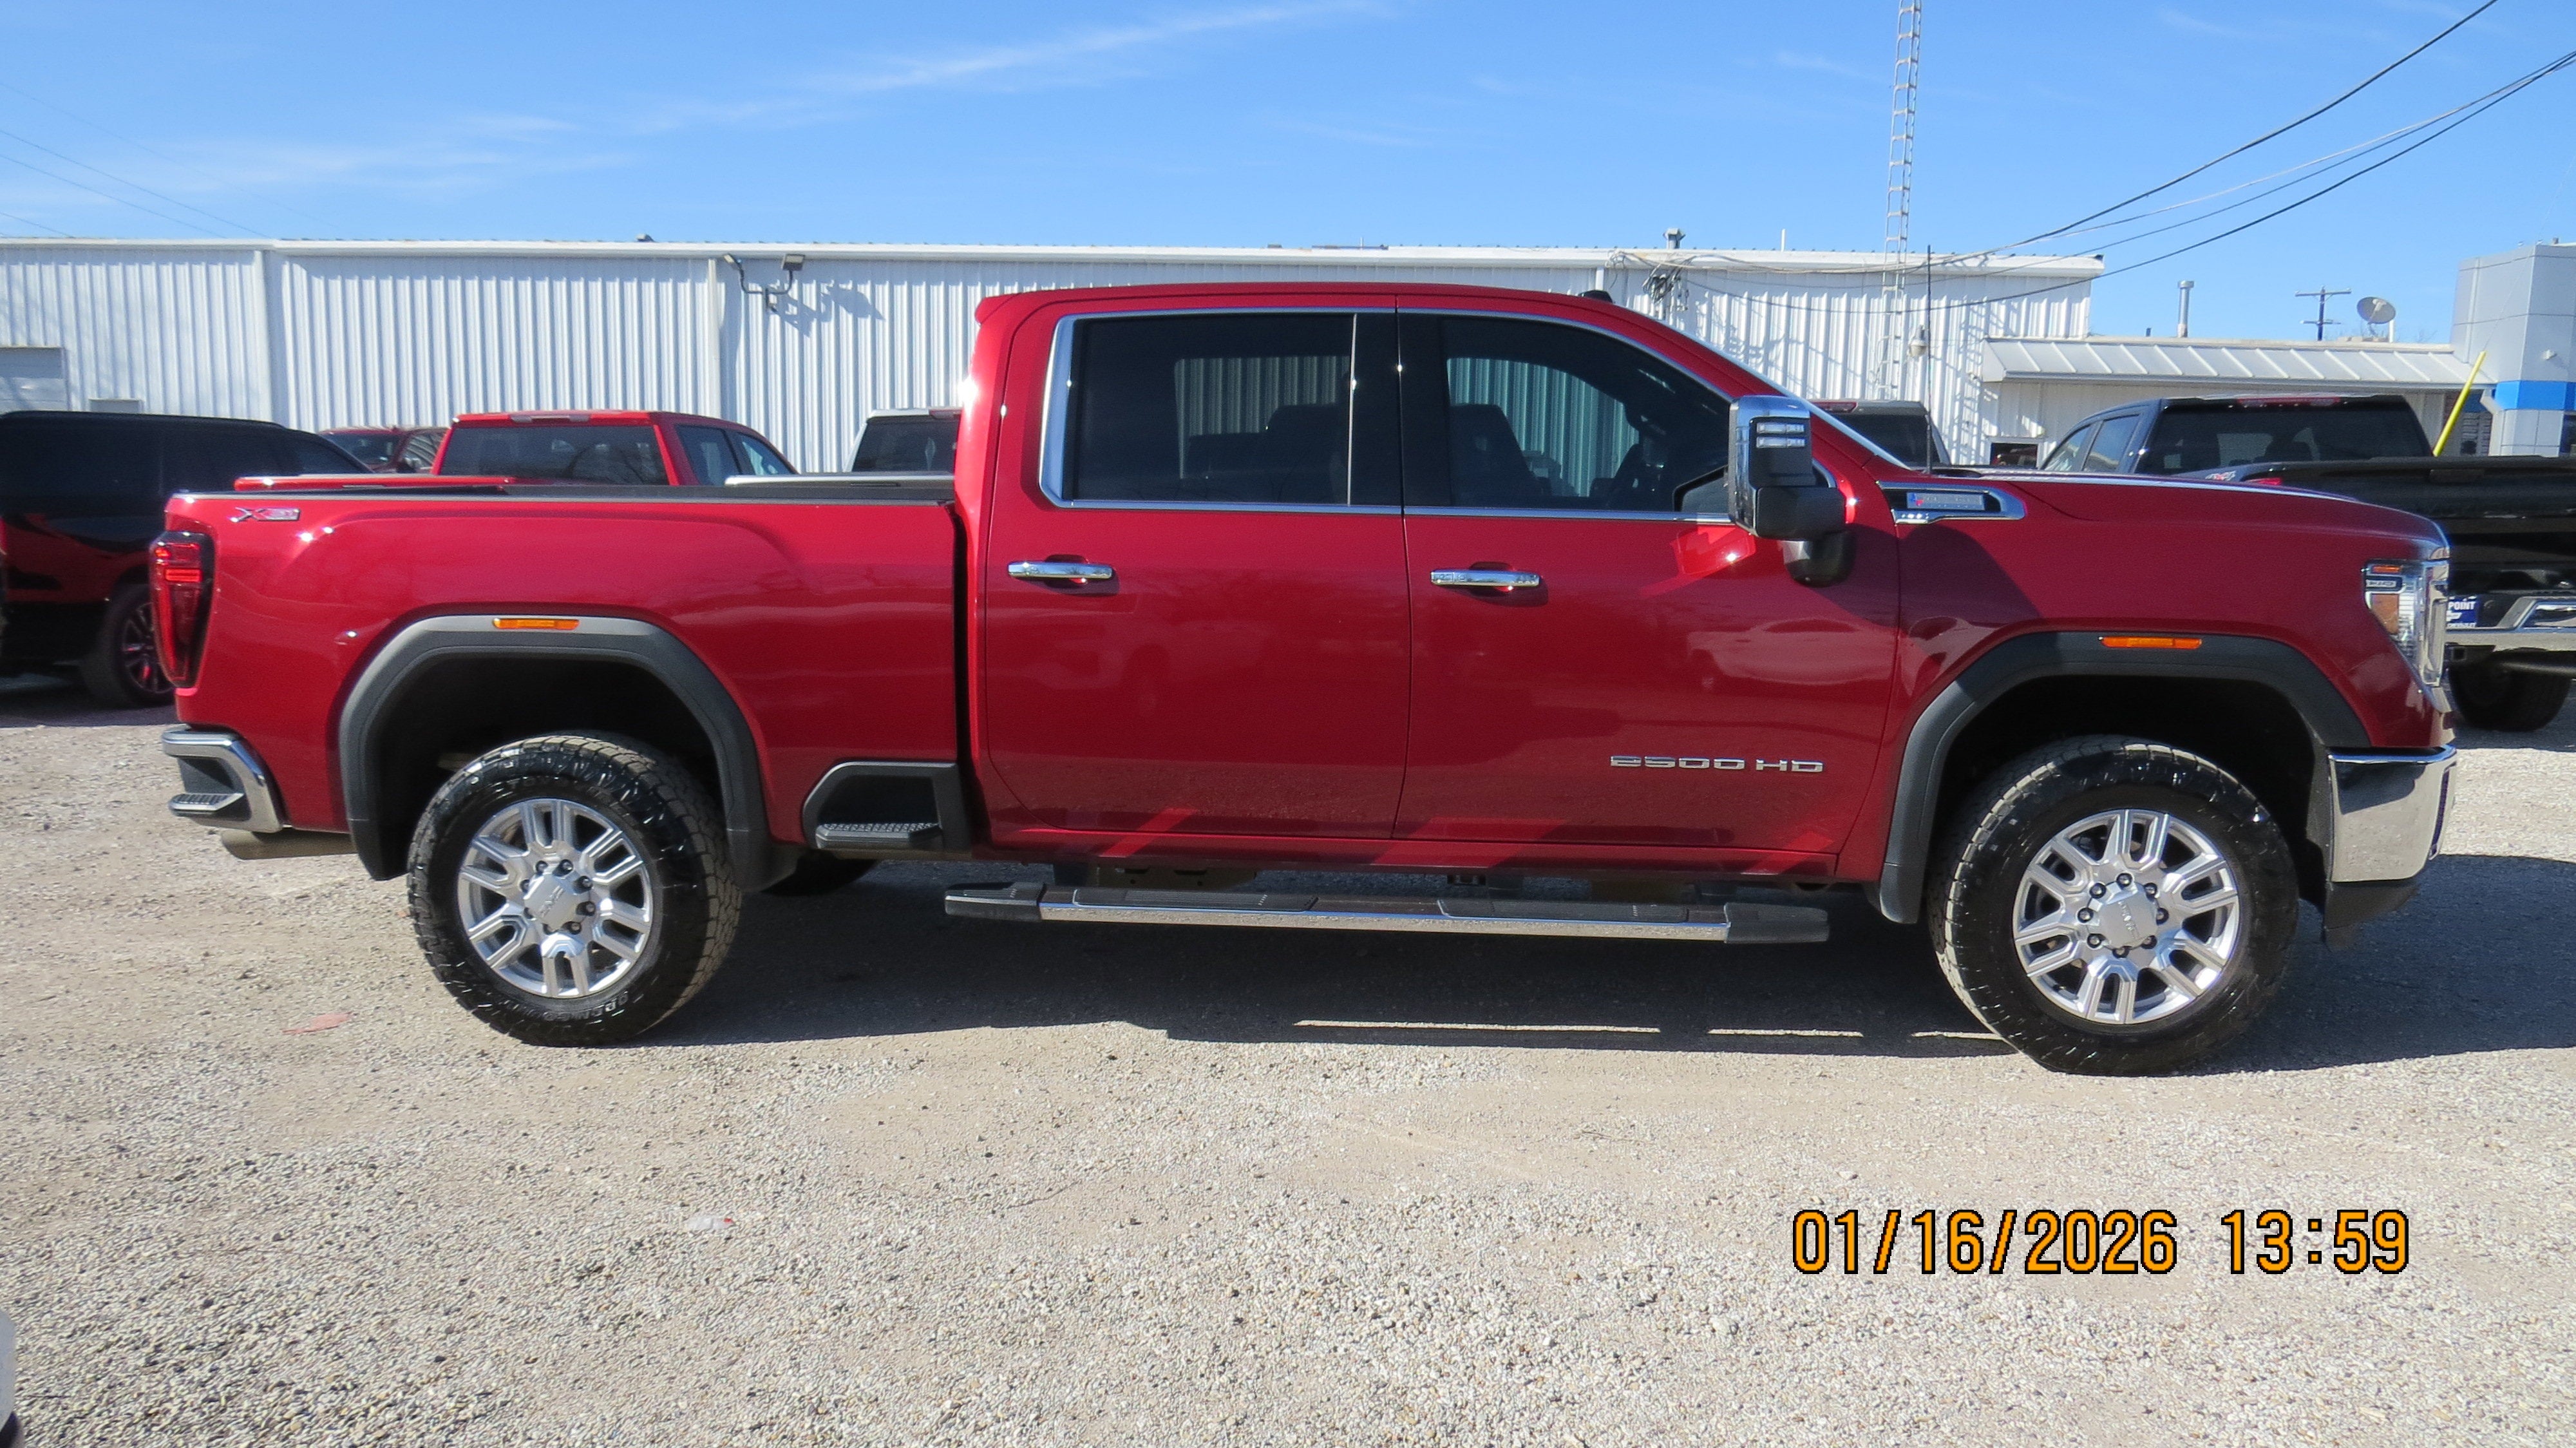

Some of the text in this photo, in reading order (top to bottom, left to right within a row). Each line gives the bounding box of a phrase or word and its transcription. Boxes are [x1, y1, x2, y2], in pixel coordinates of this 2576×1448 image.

[2448, 601, 2476, 610] POINT
[1610, 755, 1823, 773] 2500 HD
